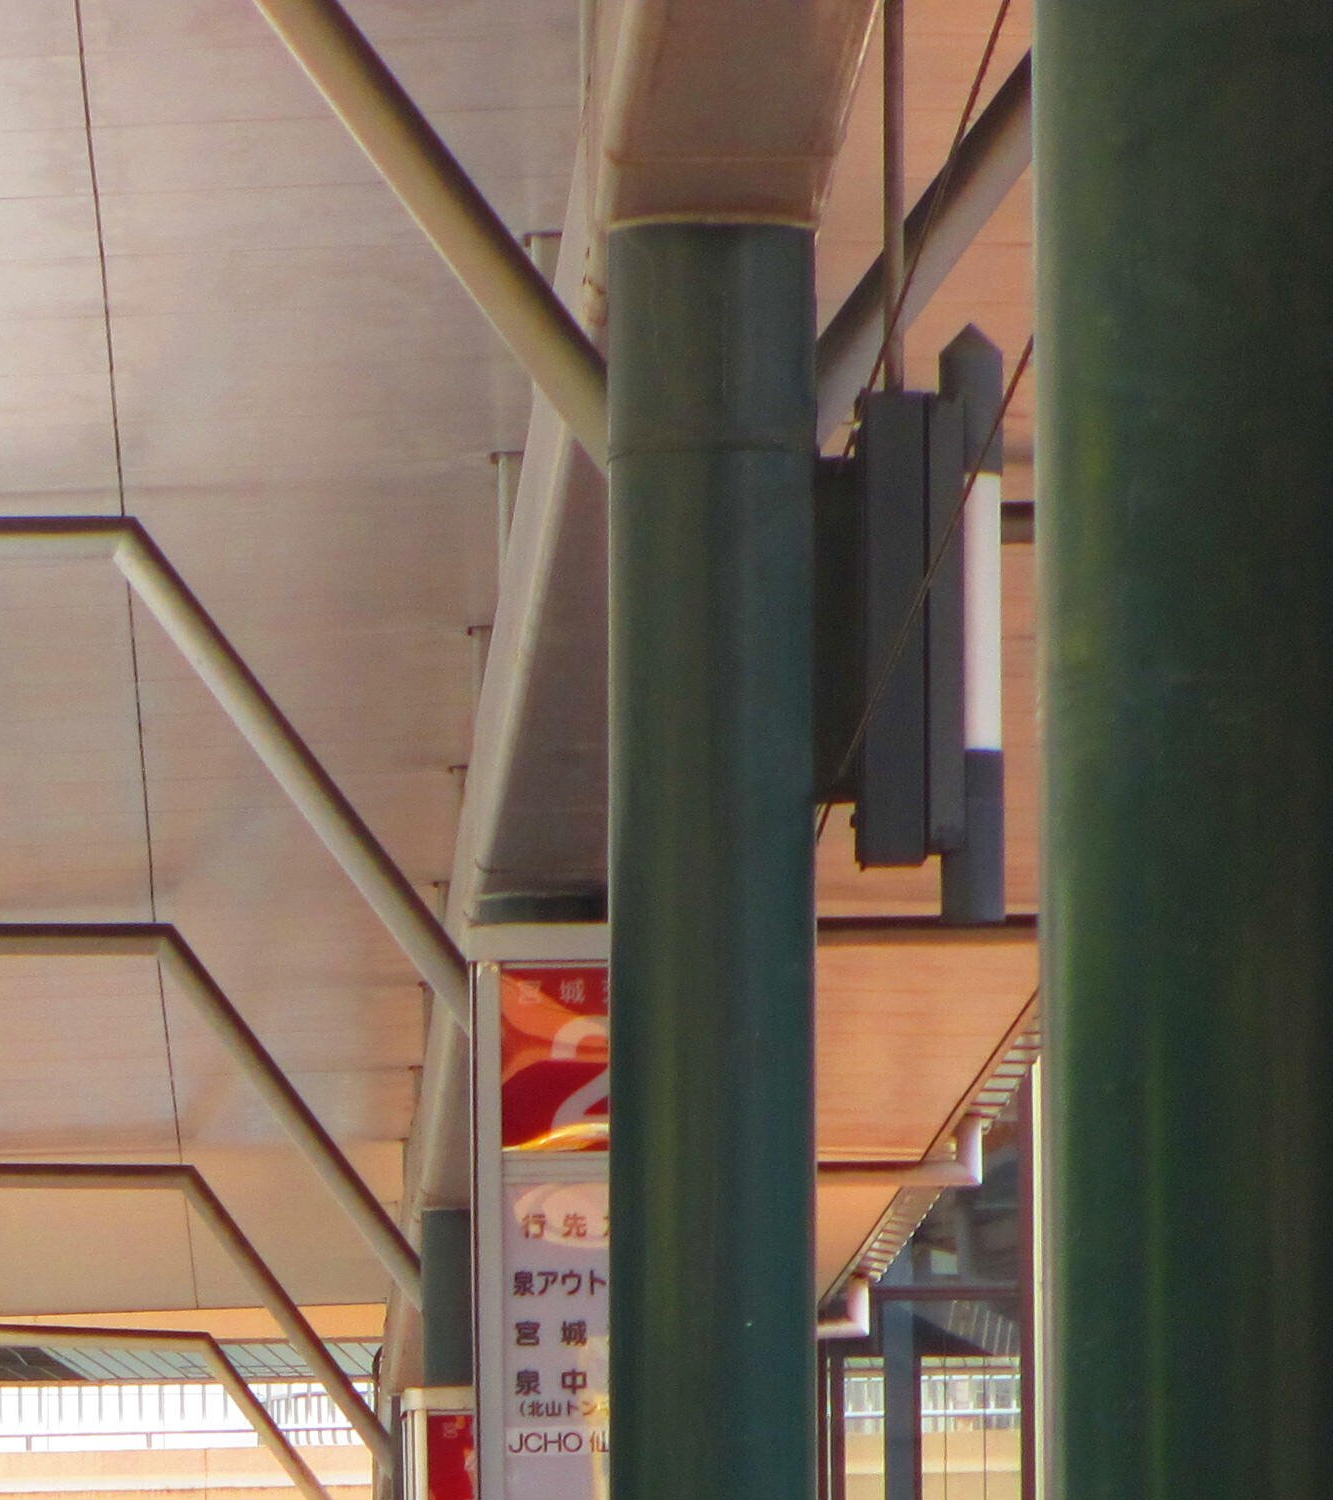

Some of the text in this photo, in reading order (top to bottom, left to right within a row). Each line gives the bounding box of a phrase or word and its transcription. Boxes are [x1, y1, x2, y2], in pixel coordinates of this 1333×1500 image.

[514, 1270, 607, 1296] 泉アウト
[515, 1369, 587, 1395] 泉中
[509, 1432, 582, 1453] JCHO
